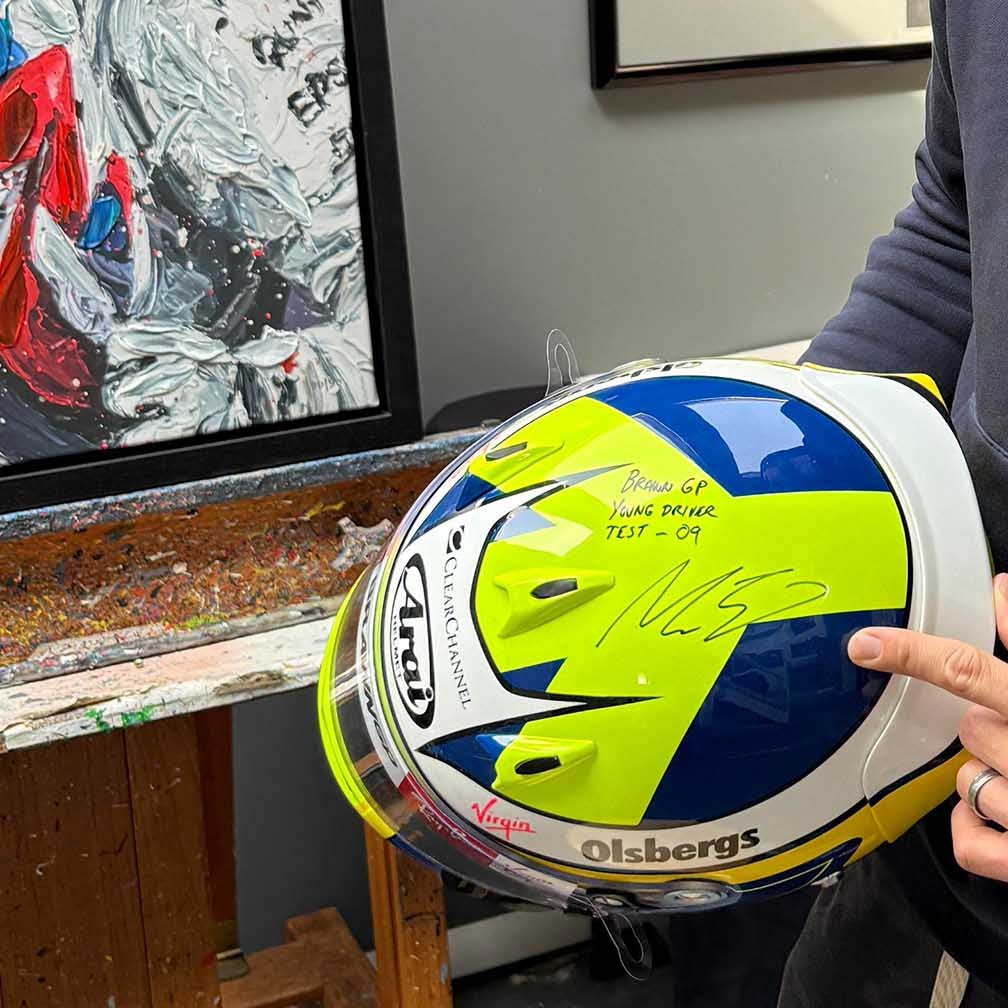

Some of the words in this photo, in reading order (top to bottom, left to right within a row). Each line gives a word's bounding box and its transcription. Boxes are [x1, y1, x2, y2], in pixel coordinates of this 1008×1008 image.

[681, 477, 708, 494] GP
[608, 499, 654, 521] YOUNG
[661, 504, 719, 518] DRIVER
[606, 524, 649, 540] TEST
[675, 523, 702, 545] 09
[391, 614, 403, 680] HELMET
[393, 557, 435, 718] Arai
[470, 797, 537, 841] Virgin
[580, 827, 762, 864] Olsbergs
